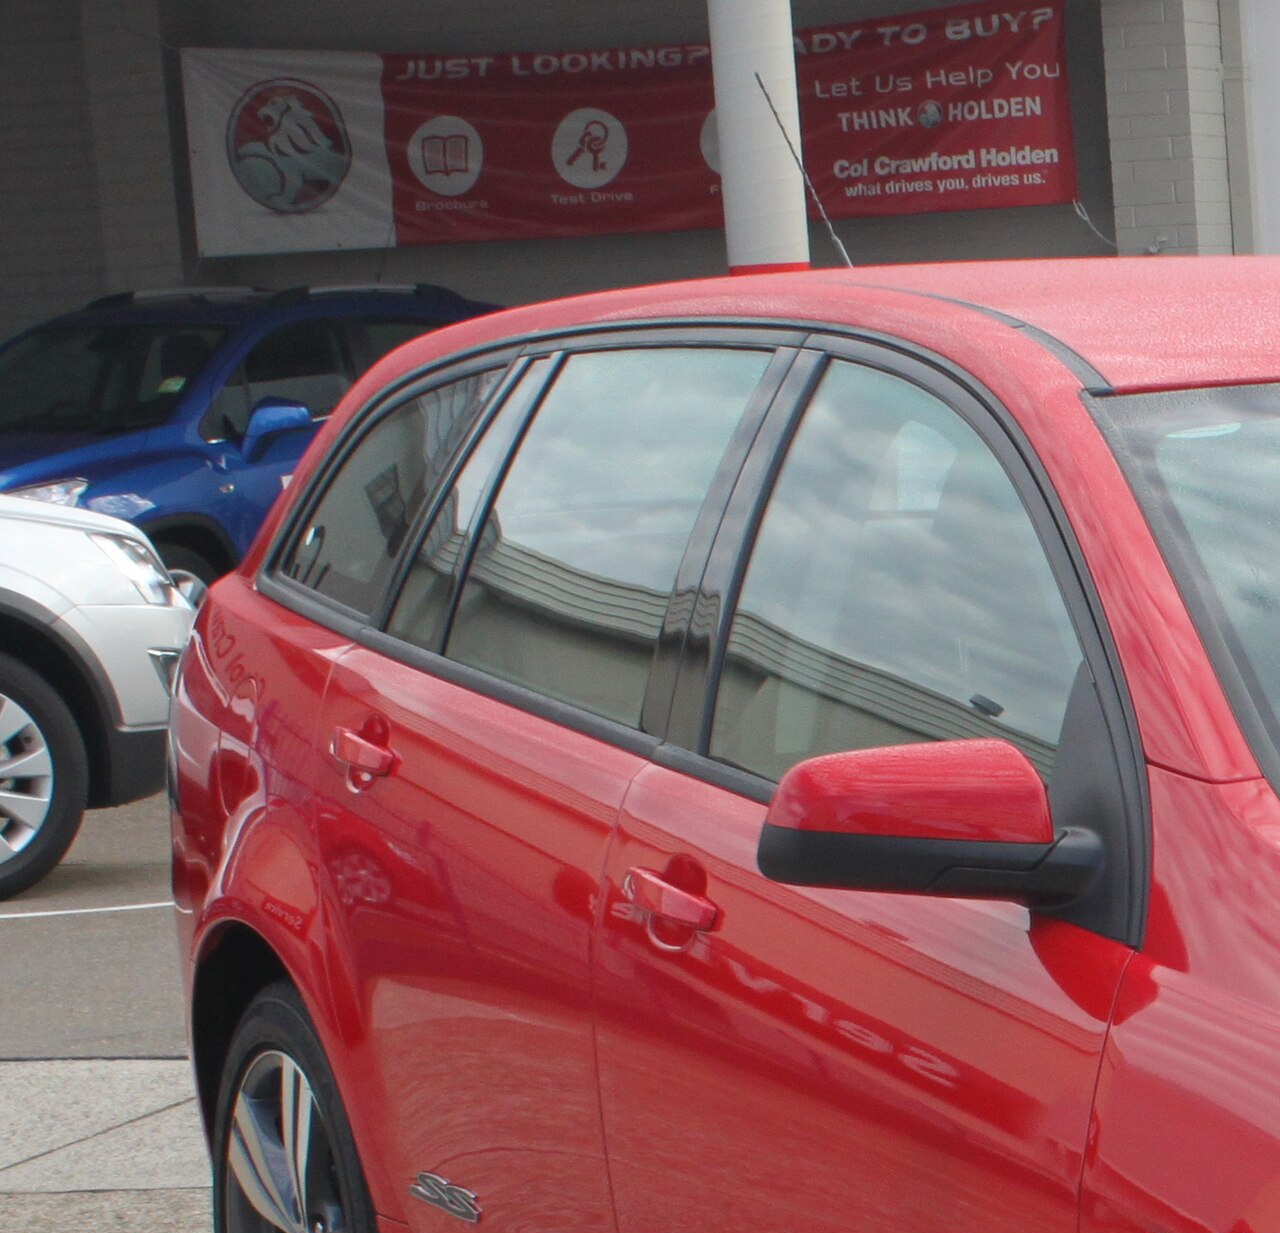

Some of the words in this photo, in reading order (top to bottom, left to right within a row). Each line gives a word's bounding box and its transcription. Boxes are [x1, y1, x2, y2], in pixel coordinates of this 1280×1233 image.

[793, 31, 862, 55] ADY
[876, 23, 928, 46] TO
[945, 7, 1054, 42] BUY?
[397, 57, 495, 80] JUST
[511, 45, 710, 77] LOOKING?
[815, 79, 861, 99] Let
[875, 73, 913, 93] Us
[926, 65, 994, 90] Help
[1005, 61, 1060, 81] You
[838, 107, 914, 132] THINK
[948, 97, 1042, 121] HOLDEN
[833, 157, 868, 180] Col
[873, 149, 976, 177] Crawford
[980, 146, 1059, 168] Holden
[552, 193, 585, 205] Test
[591, 190, 634, 203] Drive
[844, 179, 882, 197] what
[885, 176, 934, 194] drives
[937, 175, 969, 192] you,
[972, 171, 1019, 188] drives
